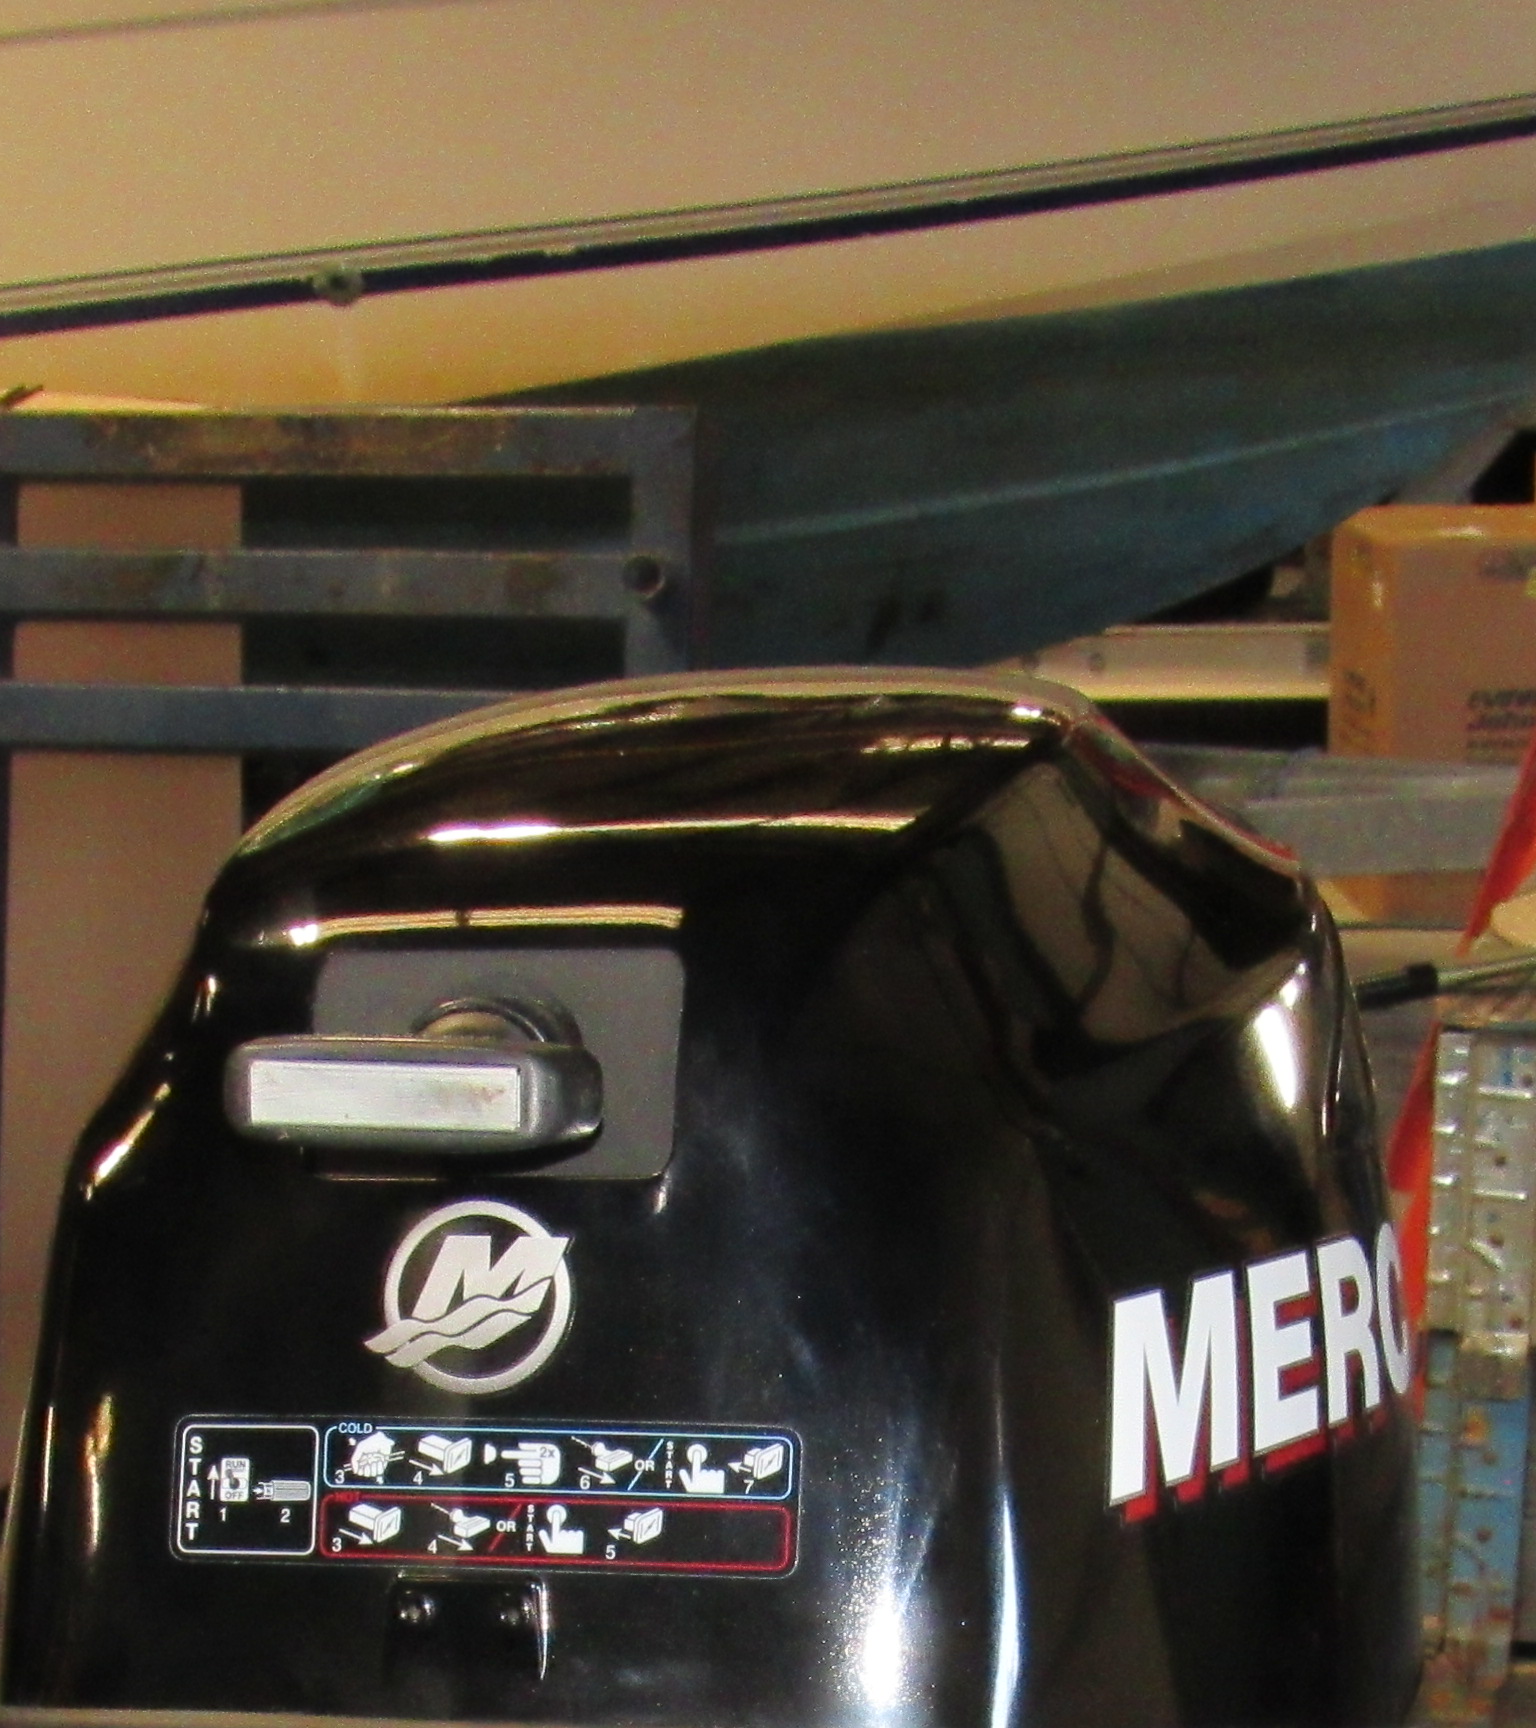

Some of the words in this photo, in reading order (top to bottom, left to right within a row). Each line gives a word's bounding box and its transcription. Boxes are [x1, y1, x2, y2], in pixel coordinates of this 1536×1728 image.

[338, 1422, 373, 1434] COLD
[225, 1460, 246, 1470] RUN
[634, 1459, 655, 1472] OR
[665, 1440, 675, 1489] START
[335, 1469, 345, 1484] 3
[413, 1471, 423, 1485] 4
[504, 1473, 515, 1488] 5
[579, 1475, 590, 1490] 6
[185, 1435, 203, 1541] START
[743, 1479, 754, 1494] 7
[225, 1491, 244, 1500] OFF
[219, 1508, 227, 1522] 1
[279, 1508, 291, 1524] 2
[496, 1519, 516, 1532] OR
[526, 1504, 535, 1552] START
[331, 1537, 342, 1552] 3
[427, 1539, 437, 1554] 4
[605, 1544, 616, 1560] 5
